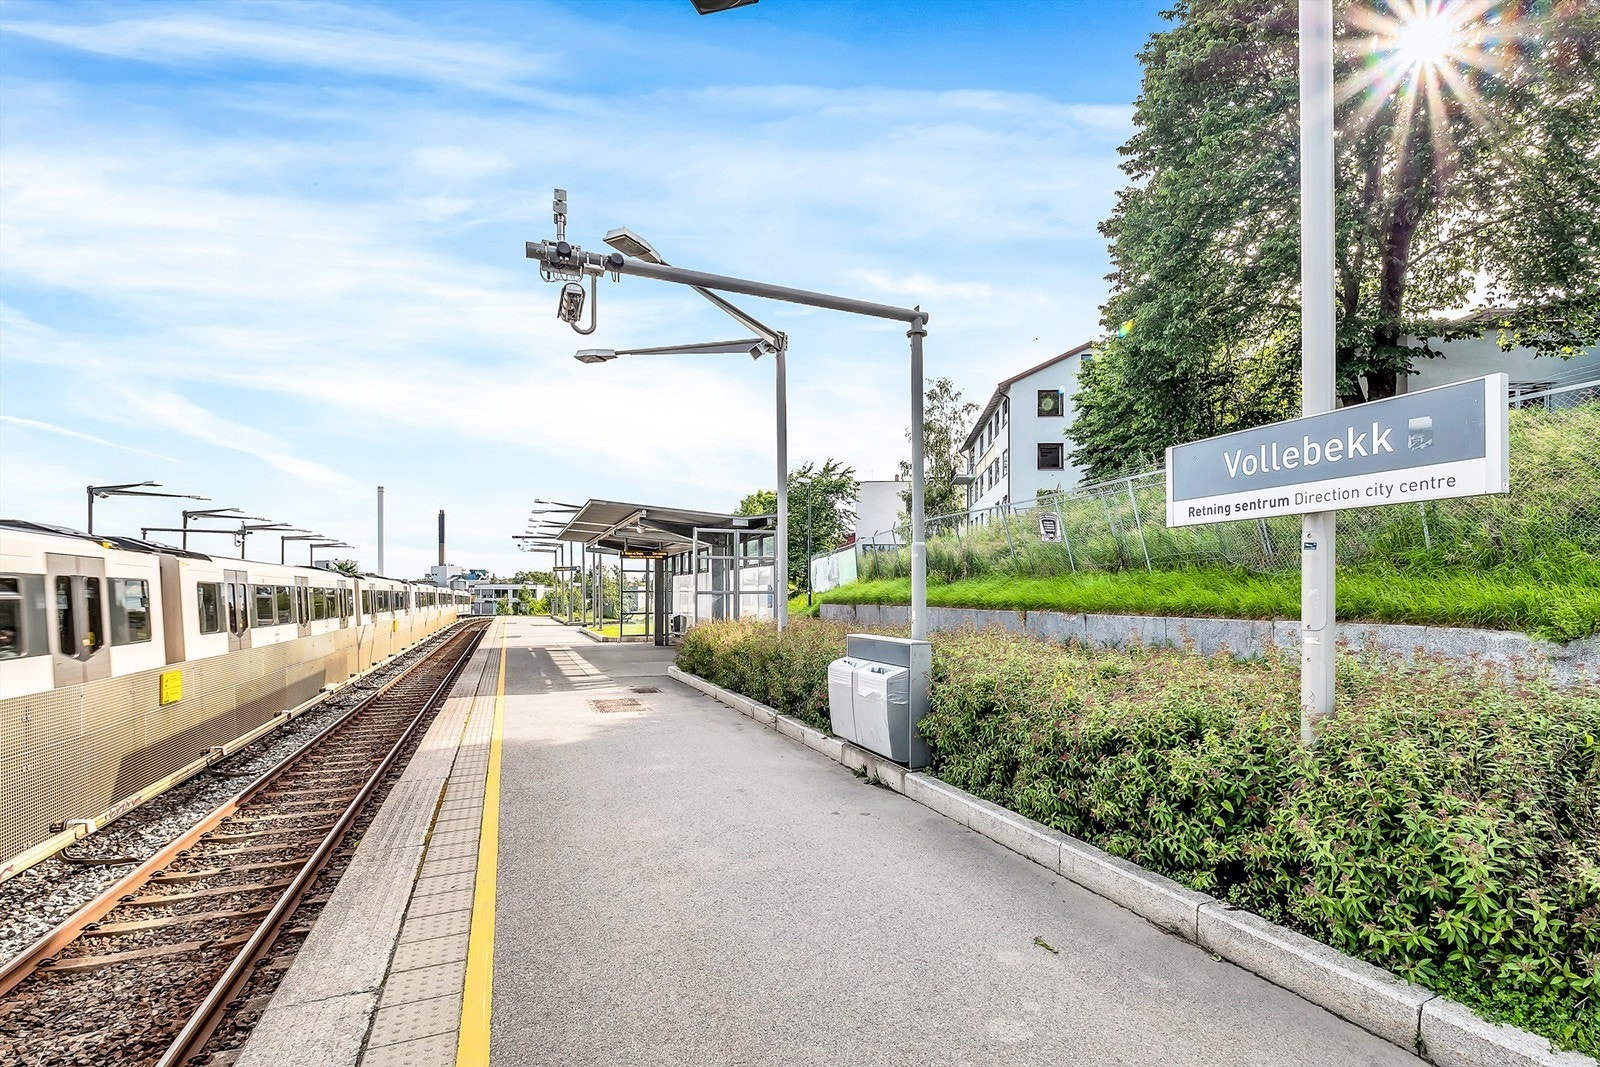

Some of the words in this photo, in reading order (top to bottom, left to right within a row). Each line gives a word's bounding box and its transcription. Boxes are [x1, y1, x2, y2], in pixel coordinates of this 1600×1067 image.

[1223, 421, 1394, 479] Vollebekk
[1188, 503, 1231, 517] Retning
[1234, 496, 1290, 512] sentrum
[1294, 487, 1360, 506] Direction
[1365, 482, 1394, 499] city
[1399, 476, 1457, 493] centre
